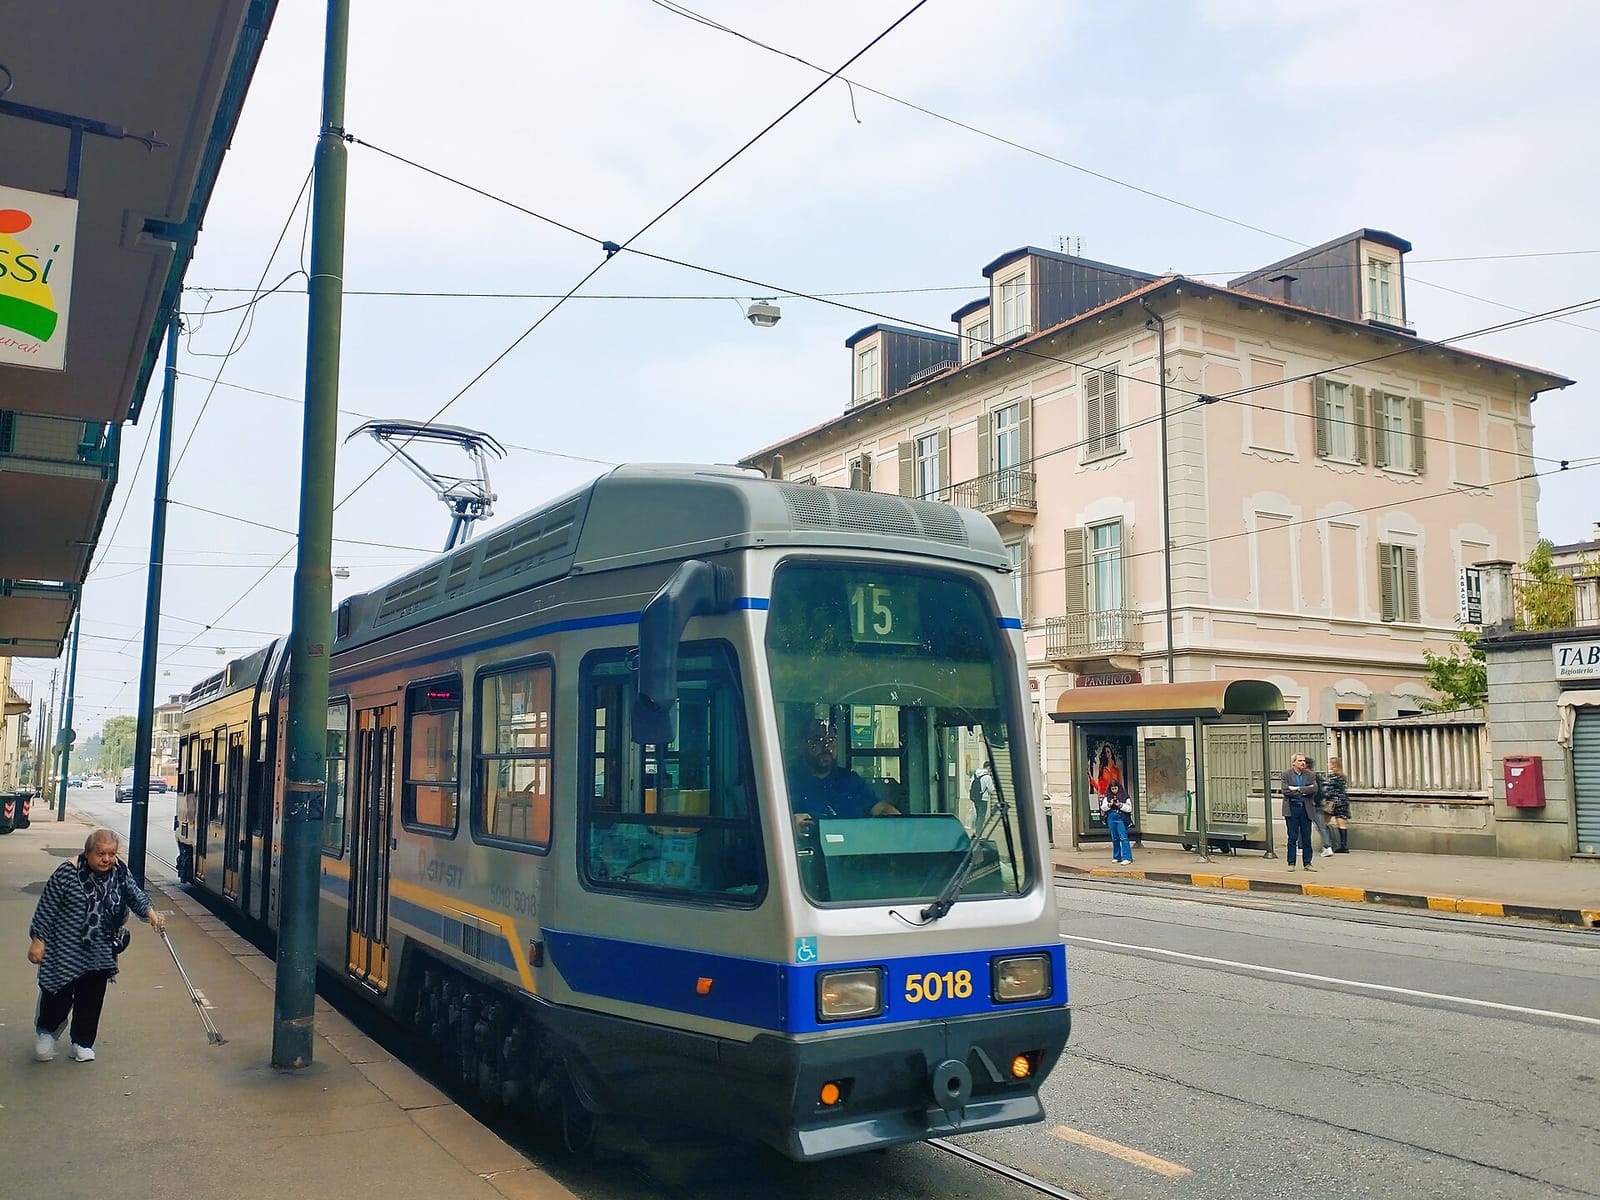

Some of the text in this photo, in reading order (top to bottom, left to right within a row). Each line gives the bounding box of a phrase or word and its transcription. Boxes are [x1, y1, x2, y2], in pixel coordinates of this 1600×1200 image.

[1460, 568, 1468, 618] TABACCHI
[851, 586, 893, 635] 15
[1084, 673, 1132, 687] PANIFICIO
[513, 889, 537, 917] 5018
[904, 969, 973, 1003] 5018
